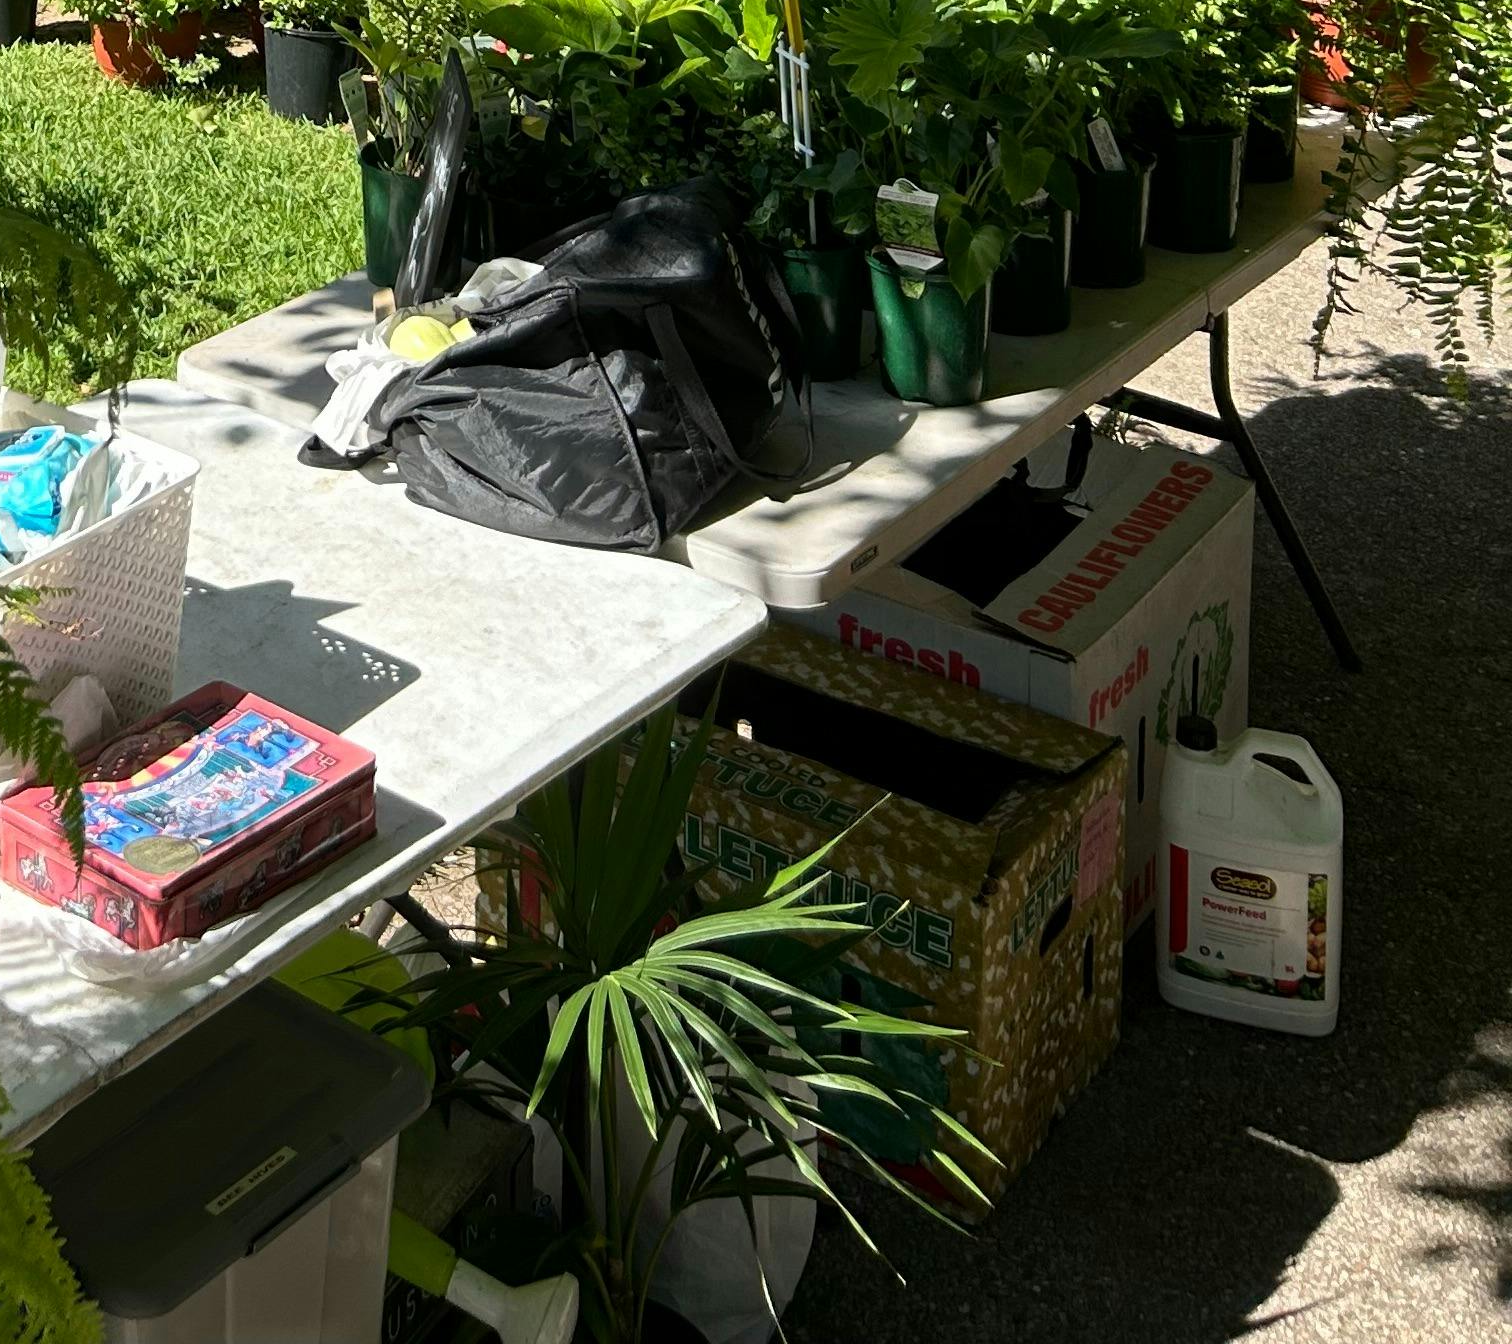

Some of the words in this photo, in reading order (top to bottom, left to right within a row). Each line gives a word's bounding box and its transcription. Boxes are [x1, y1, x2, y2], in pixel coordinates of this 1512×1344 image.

[1016, 459, 1214, 633] CAULIFLOWERS
[837, 612, 981, 689] fresh
[1088, 644, 1150, 728] fresh
[1201, 896, 1267, 921] PowerFeed
